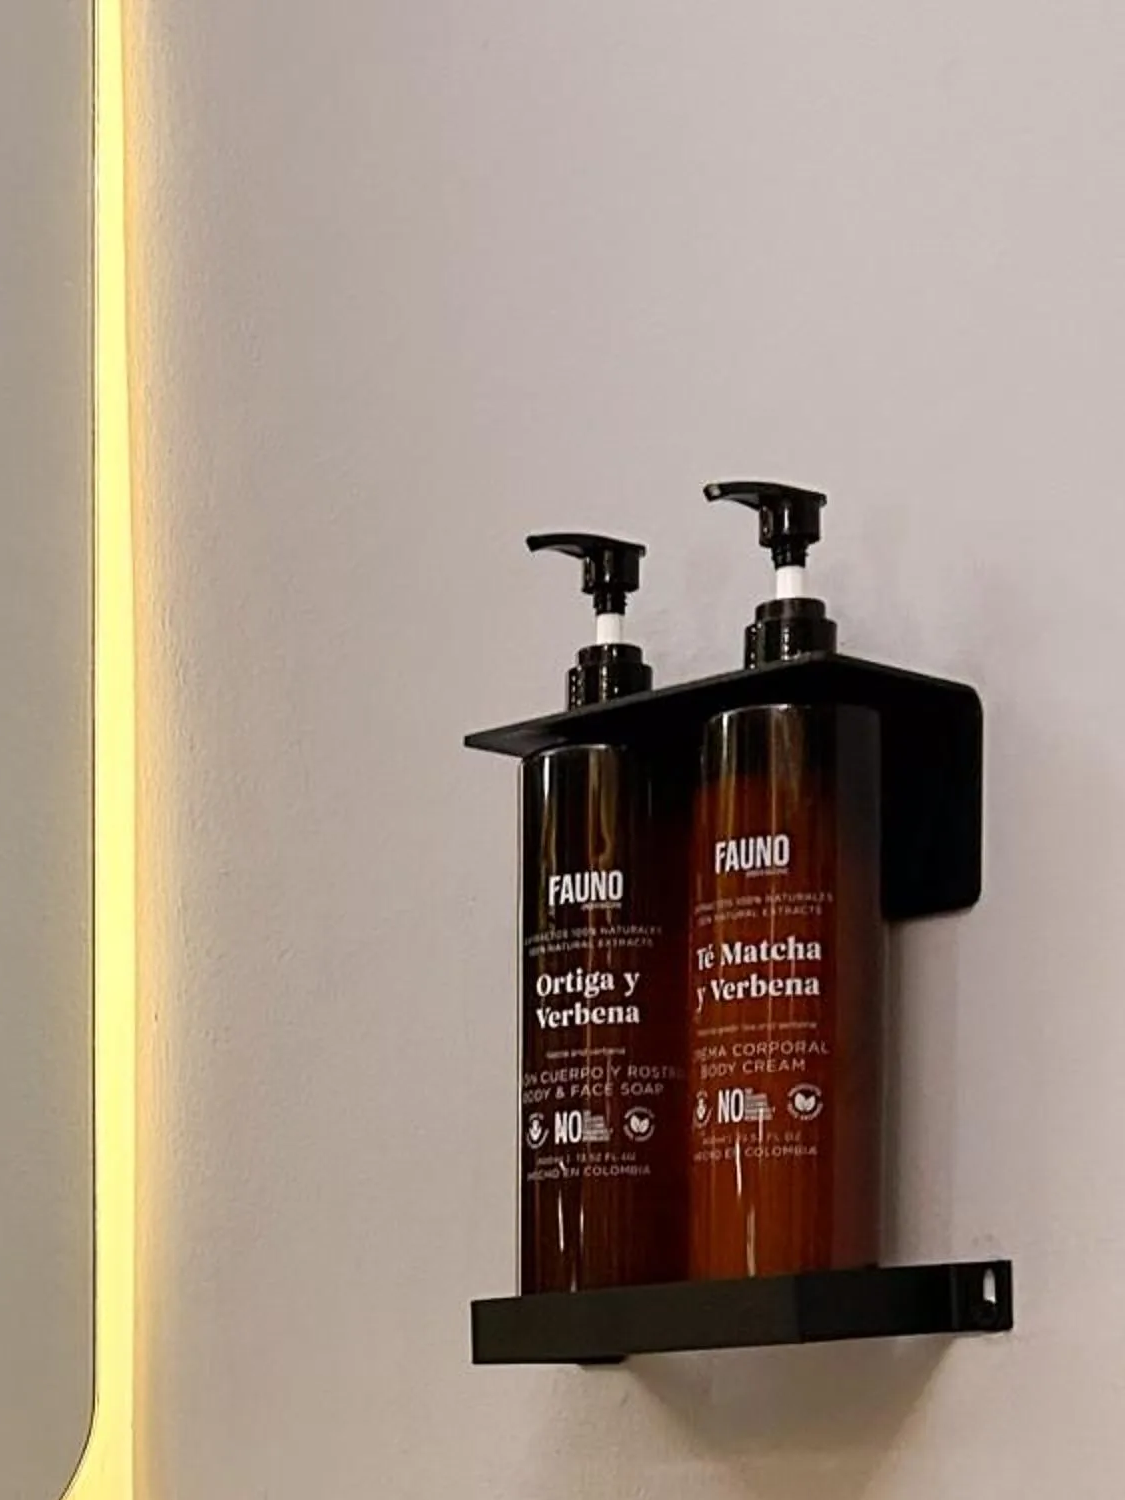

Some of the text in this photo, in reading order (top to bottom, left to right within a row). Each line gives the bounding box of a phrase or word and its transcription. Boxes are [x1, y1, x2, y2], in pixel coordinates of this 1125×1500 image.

[715, 834, 790, 875] FAUNO
[548, 870, 624, 906] FAUNO
[697, 935, 821, 971] Té Matcha
[536, 967, 640, 998] Ortiga y
[710, 973, 820, 1001] Verbena
[536, 1001, 640, 1029] Verbena
[732, 1039, 830, 1057] CORPORAL
[540, 1066, 604, 1085] CUERPO
[609, 1065, 621, 1078] Y
[701, 1058, 806, 1079] BODY CREAM
[555, 1087, 565, 1100] &
[570, 1082, 613, 1099] FACE
[620, 1082, 664, 1097] SOAP
[718, 1087, 743, 1124] NO
[554, 1110, 582, 1145] NO
[583, 1164, 651, 1177] COLOMBIA
